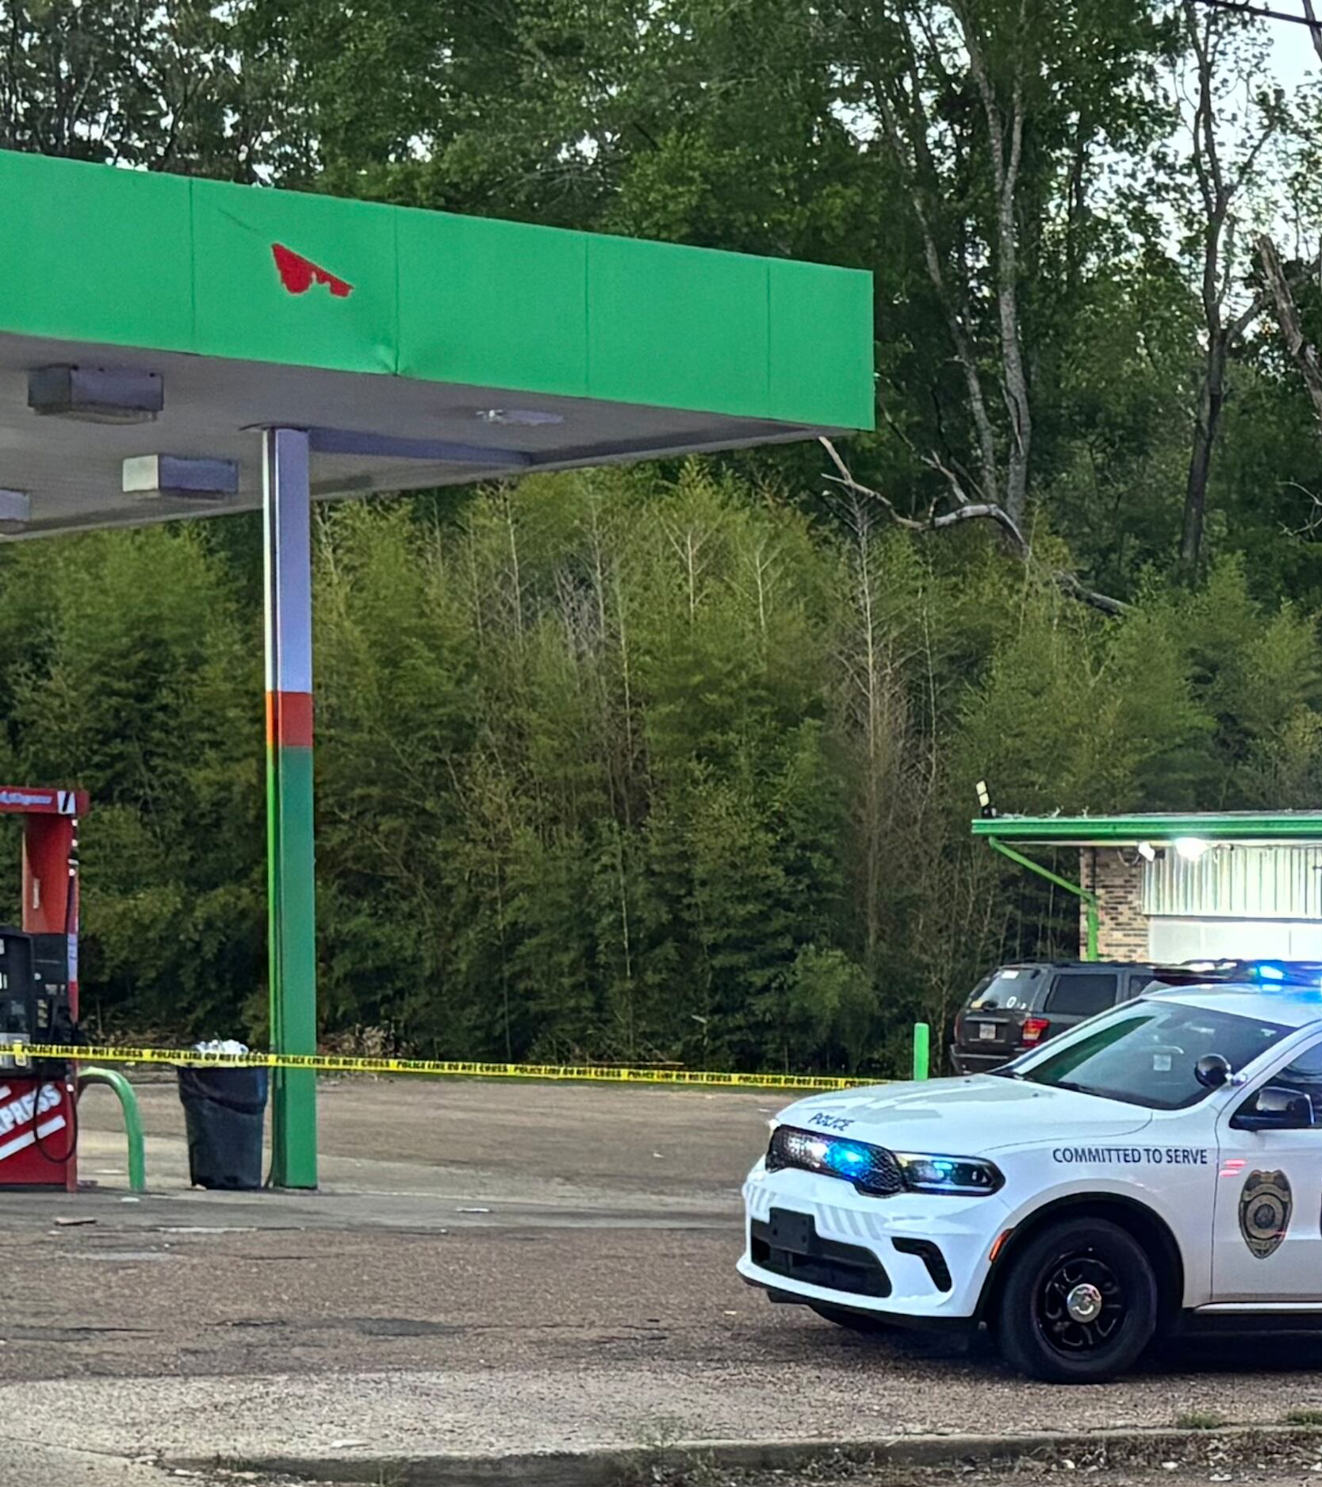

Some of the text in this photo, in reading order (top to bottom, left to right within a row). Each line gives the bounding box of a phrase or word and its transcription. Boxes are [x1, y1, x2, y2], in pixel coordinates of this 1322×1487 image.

[21, 1046, 52, 1056] POLICE
[93, 1048, 109, 1058] NOT
[151, 1051, 181, 1059] POLICE
[0, 1084, 62, 1136] PRESS
[1053, 1147, 1207, 1165] COMMITTED TO SERVE
